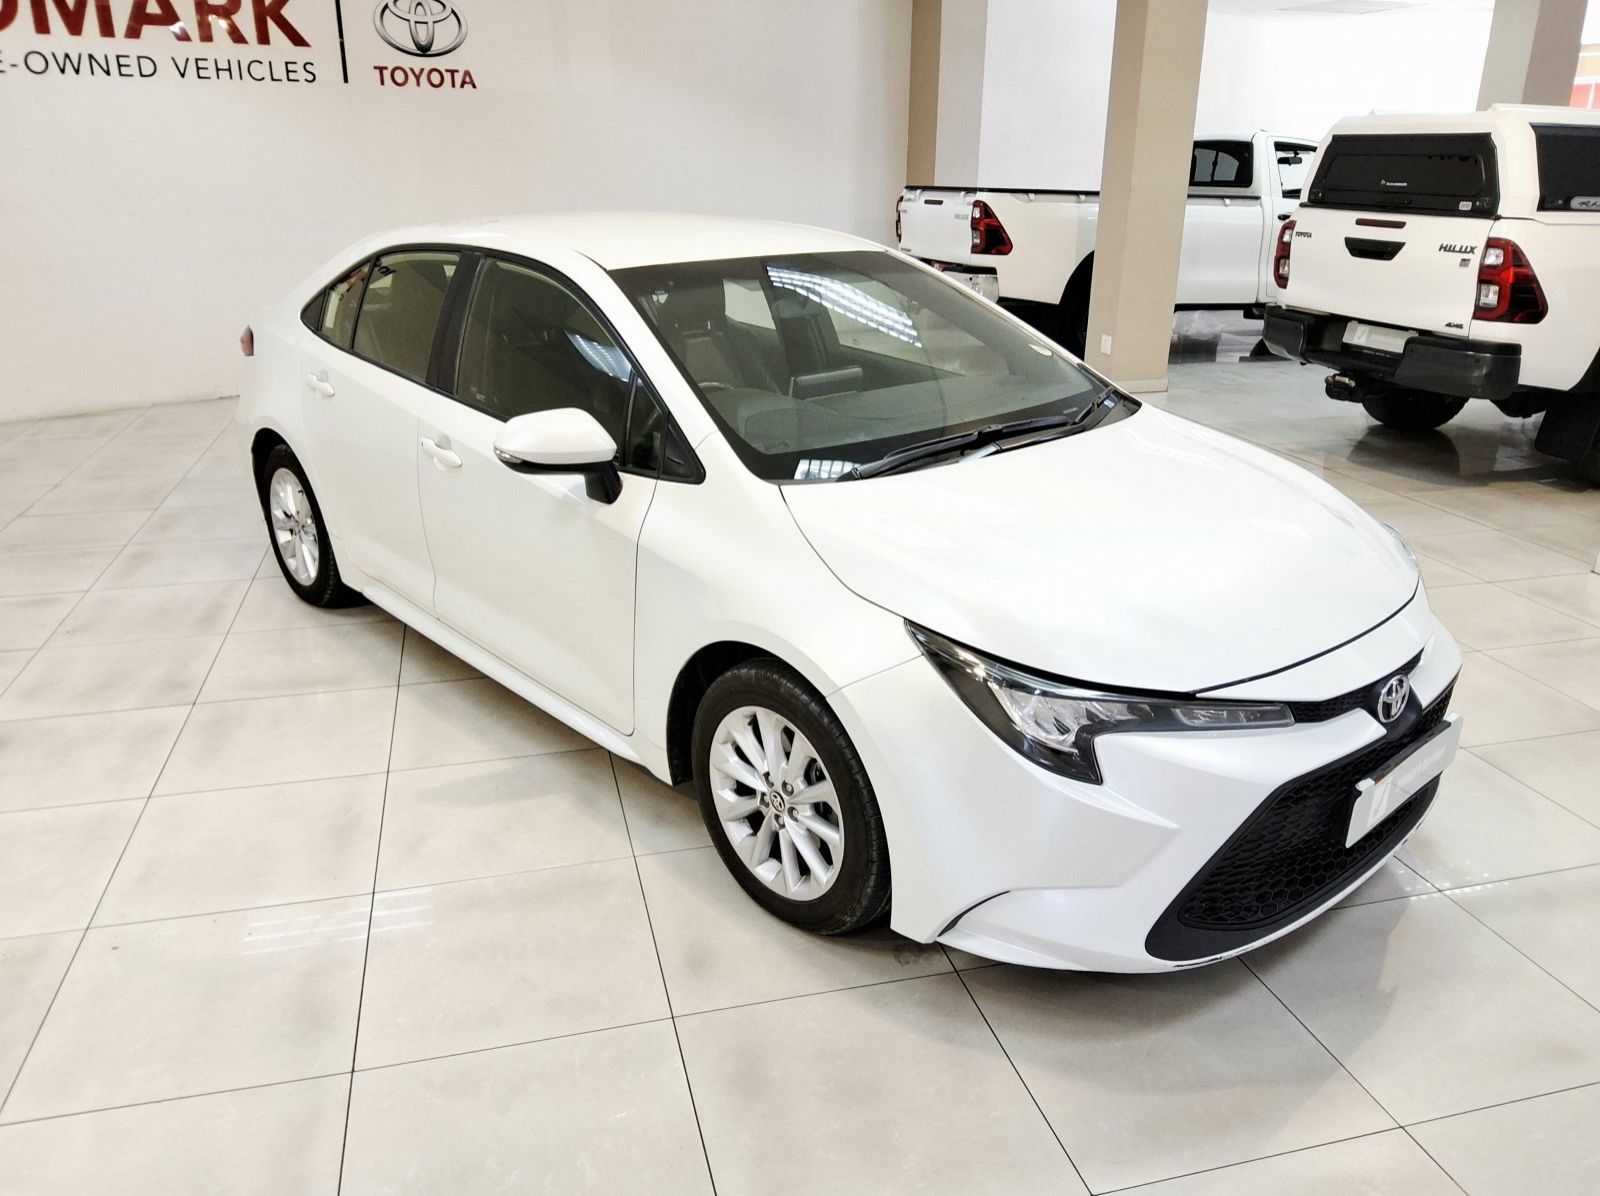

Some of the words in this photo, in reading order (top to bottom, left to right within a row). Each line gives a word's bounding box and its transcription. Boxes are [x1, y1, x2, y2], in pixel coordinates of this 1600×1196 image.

[171, 56, 317, 83] VEHICLES
[373, 65, 477, 89] TOYOTA
[1438, 243, 1478, 254] HILUX
